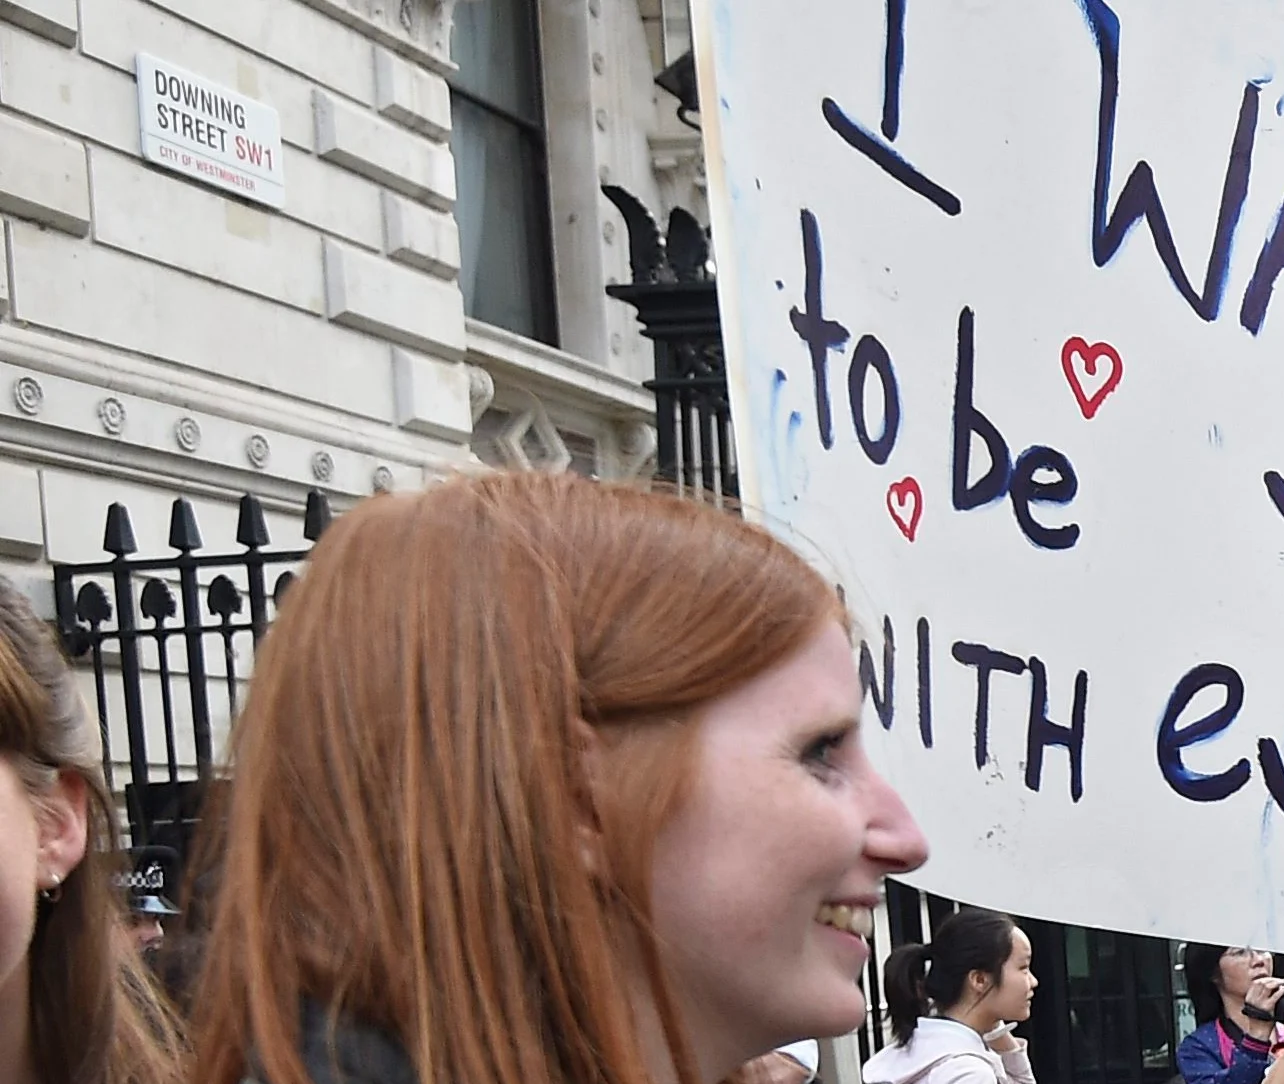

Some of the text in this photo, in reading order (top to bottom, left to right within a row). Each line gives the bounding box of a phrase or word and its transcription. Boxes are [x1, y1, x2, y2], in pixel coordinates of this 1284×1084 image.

[154, 69, 246, 129] DOWNING
[820, 0, 961, 216] I
[156, 103, 273, 171] STREET SW1
[159, 145, 256, 192] CITY OF WESTMINSTER
[790, 208, 1080, 551] to be
